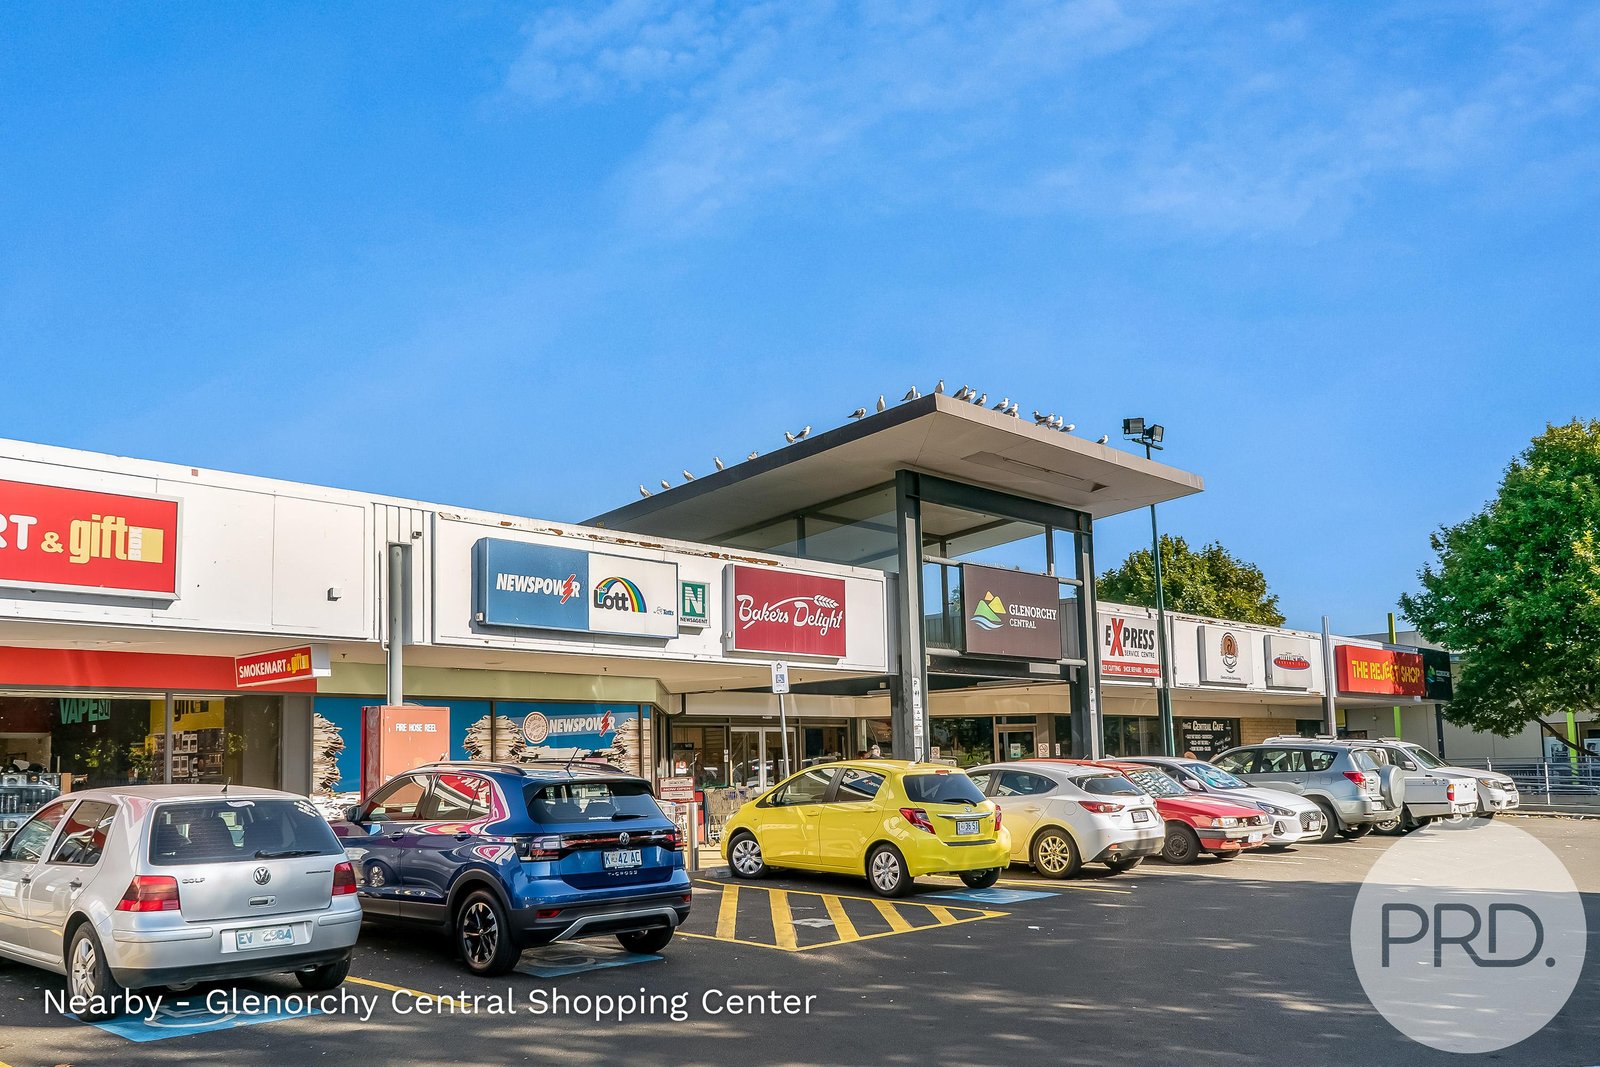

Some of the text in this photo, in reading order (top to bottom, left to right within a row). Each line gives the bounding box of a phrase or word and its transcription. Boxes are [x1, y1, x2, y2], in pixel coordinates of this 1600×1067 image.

[41, 532, 64, 553] &
[69, 514, 127, 564] gift
[594, 589, 629, 611] Lott
[680, 616, 708, 624] NEWSAGENT
[736, 594, 844, 636] Bakers Delight
[1009, 604, 1057, 620] GLENORCHY
[1009, 618, 1037, 629] CENTRAL
[1105, 617, 1155, 656] EXPRESS
[239, 659, 287, 678] SMOKEMART
[1351, 660, 1420, 683] THE REJECT SHOP
[60, 698, 98, 724] VAPE
[395, 723, 437, 732] FIRE HOSE REEL
[238, 931, 254, 944] EV
